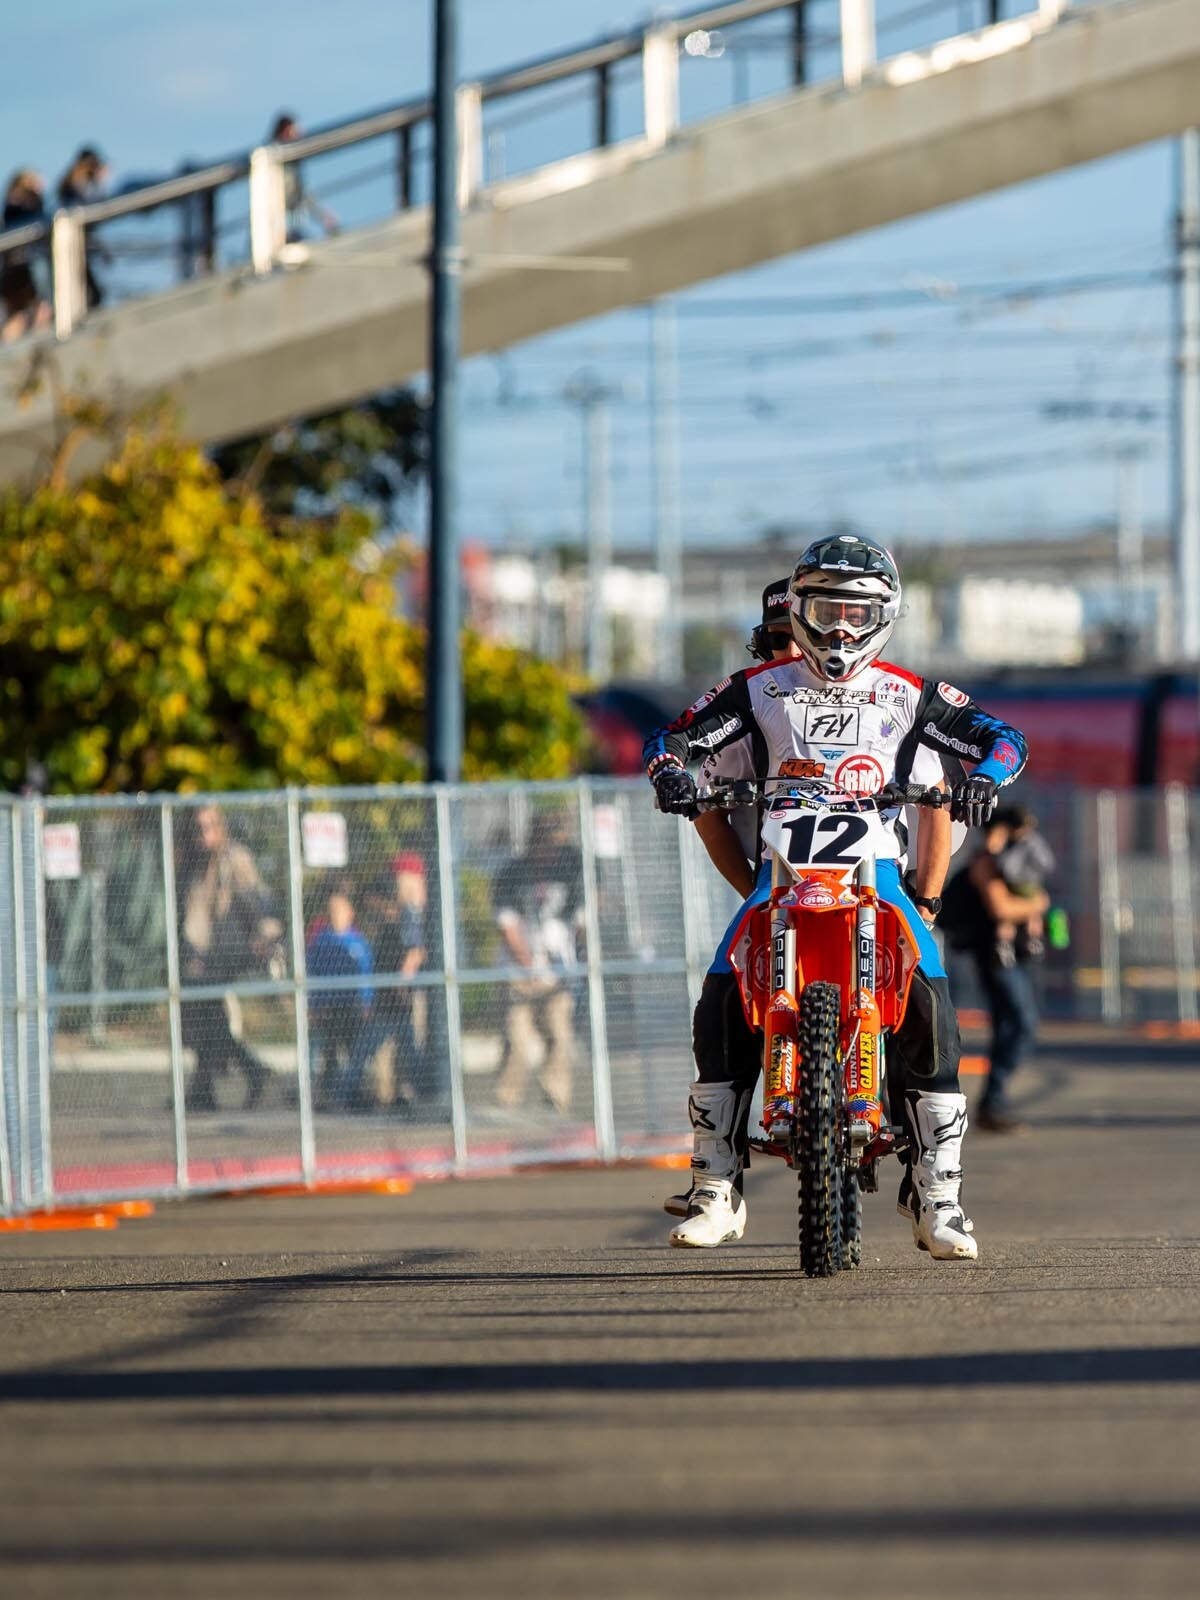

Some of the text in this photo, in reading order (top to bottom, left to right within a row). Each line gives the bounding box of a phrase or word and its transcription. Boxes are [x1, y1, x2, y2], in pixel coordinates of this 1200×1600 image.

[831, 687, 870, 697] MOUNTAIN
[809, 713, 854, 738] FLY
[778, 759, 825, 777] KTM
[781, 814, 869, 865] 12
[785, 1034, 793, 1092] DUNLOP
[859, 1031, 873, 1089] GALFER
